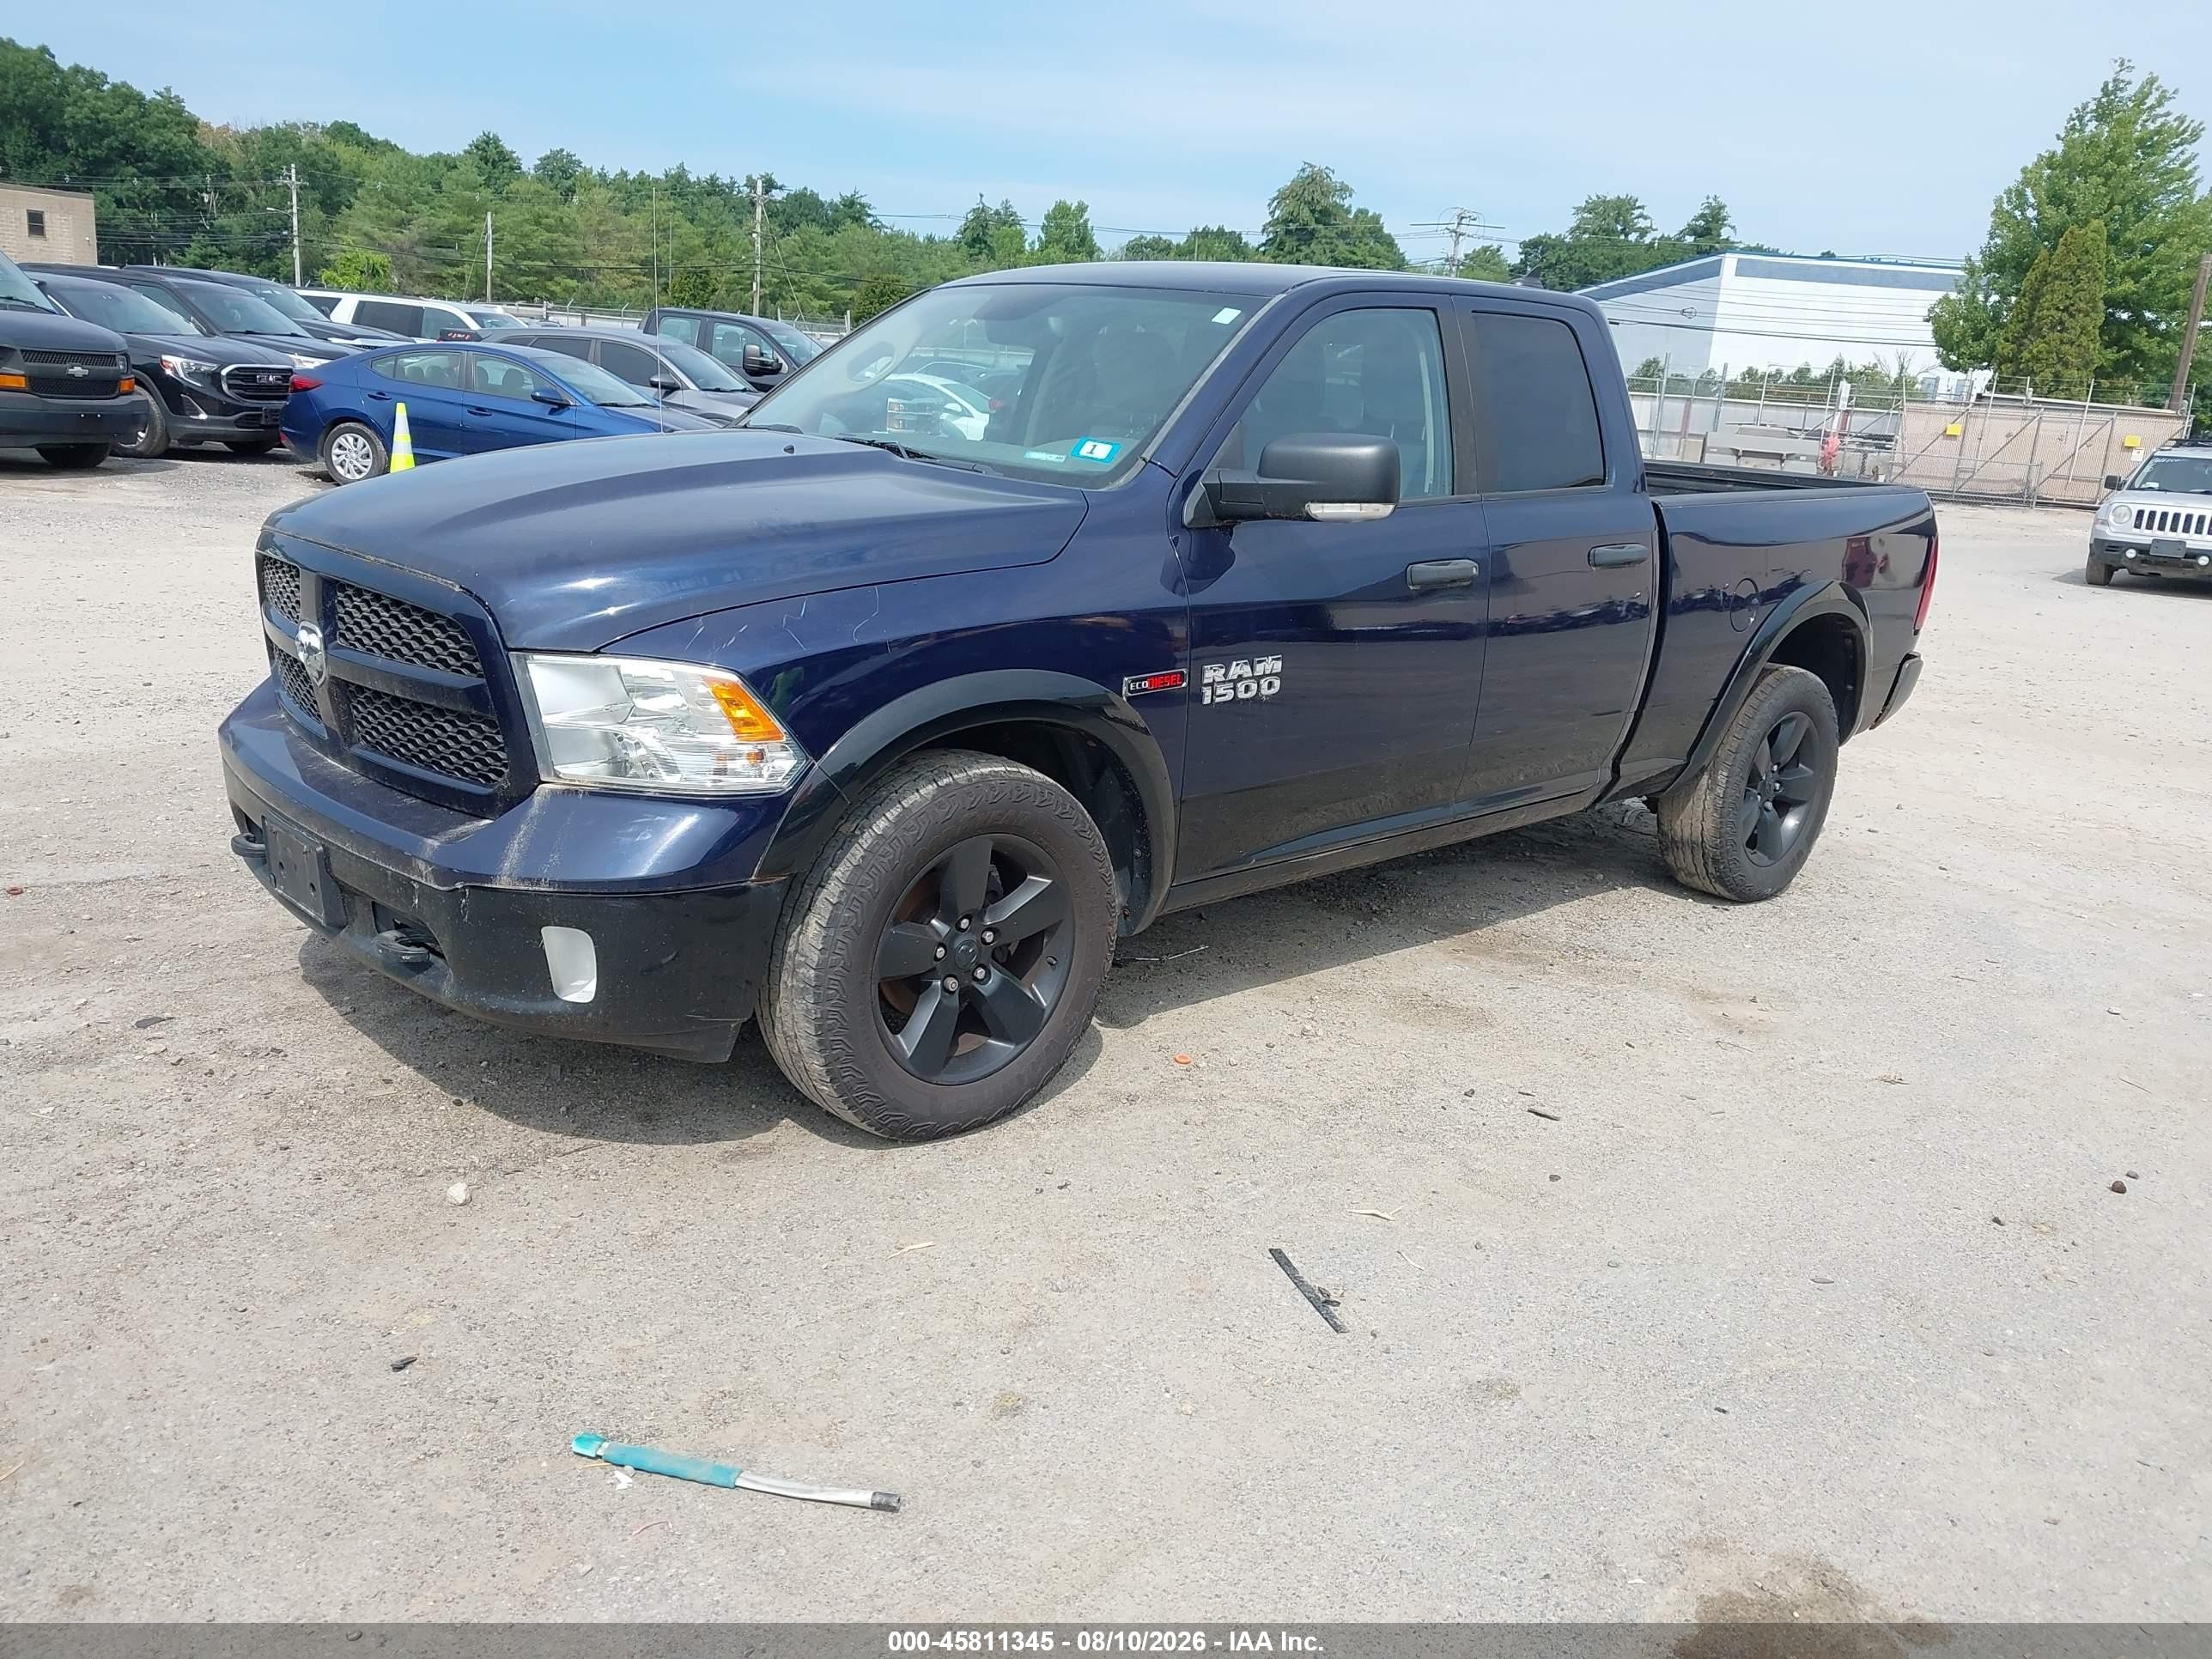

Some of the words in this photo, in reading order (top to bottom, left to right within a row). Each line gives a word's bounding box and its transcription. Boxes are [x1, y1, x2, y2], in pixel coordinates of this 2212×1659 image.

[1086, 444, 1097, 455] 1
[1202, 654, 1283, 684] RAM
[1129, 673, 1182, 690] ECODIESEL
[1202, 676, 1281, 705] 1500
